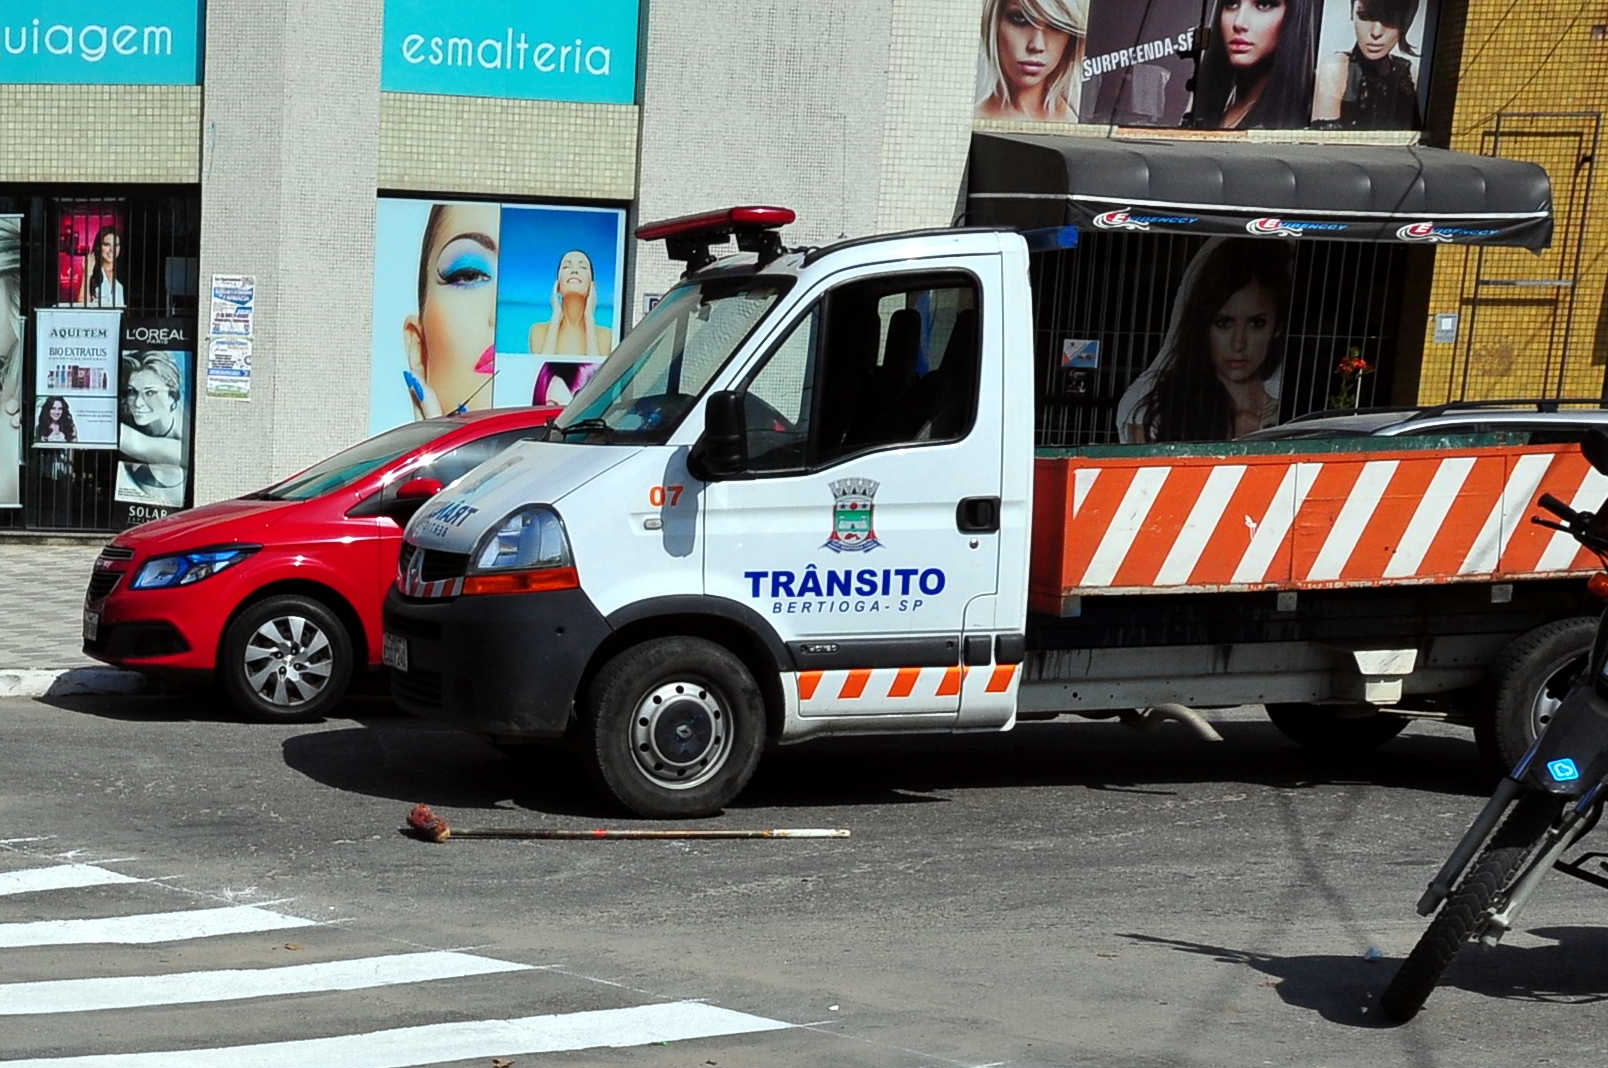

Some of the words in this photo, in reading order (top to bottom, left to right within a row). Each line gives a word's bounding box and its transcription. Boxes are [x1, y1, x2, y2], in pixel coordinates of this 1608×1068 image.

[402, 27, 611, 75] esmalteria
[1112, 213, 1199, 225] EVIDENCCY
[1263, 218, 1348, 231] EVIDENCCY
[50, 328, 81, 338] AQUI
[82, 328, 108, 338] TEM
[126, 327, 188, 341] L'ORÉAL
[49, 347, 64, 356] BIO
[64, 347, 108, 357] EXTRATUS
[649, 485, 684, 507] 07
[128, 505, 168, 519] SOLAR
[744, 563, 946, 598] TRÂNSITO
[898, 599, 924, 612] SP
